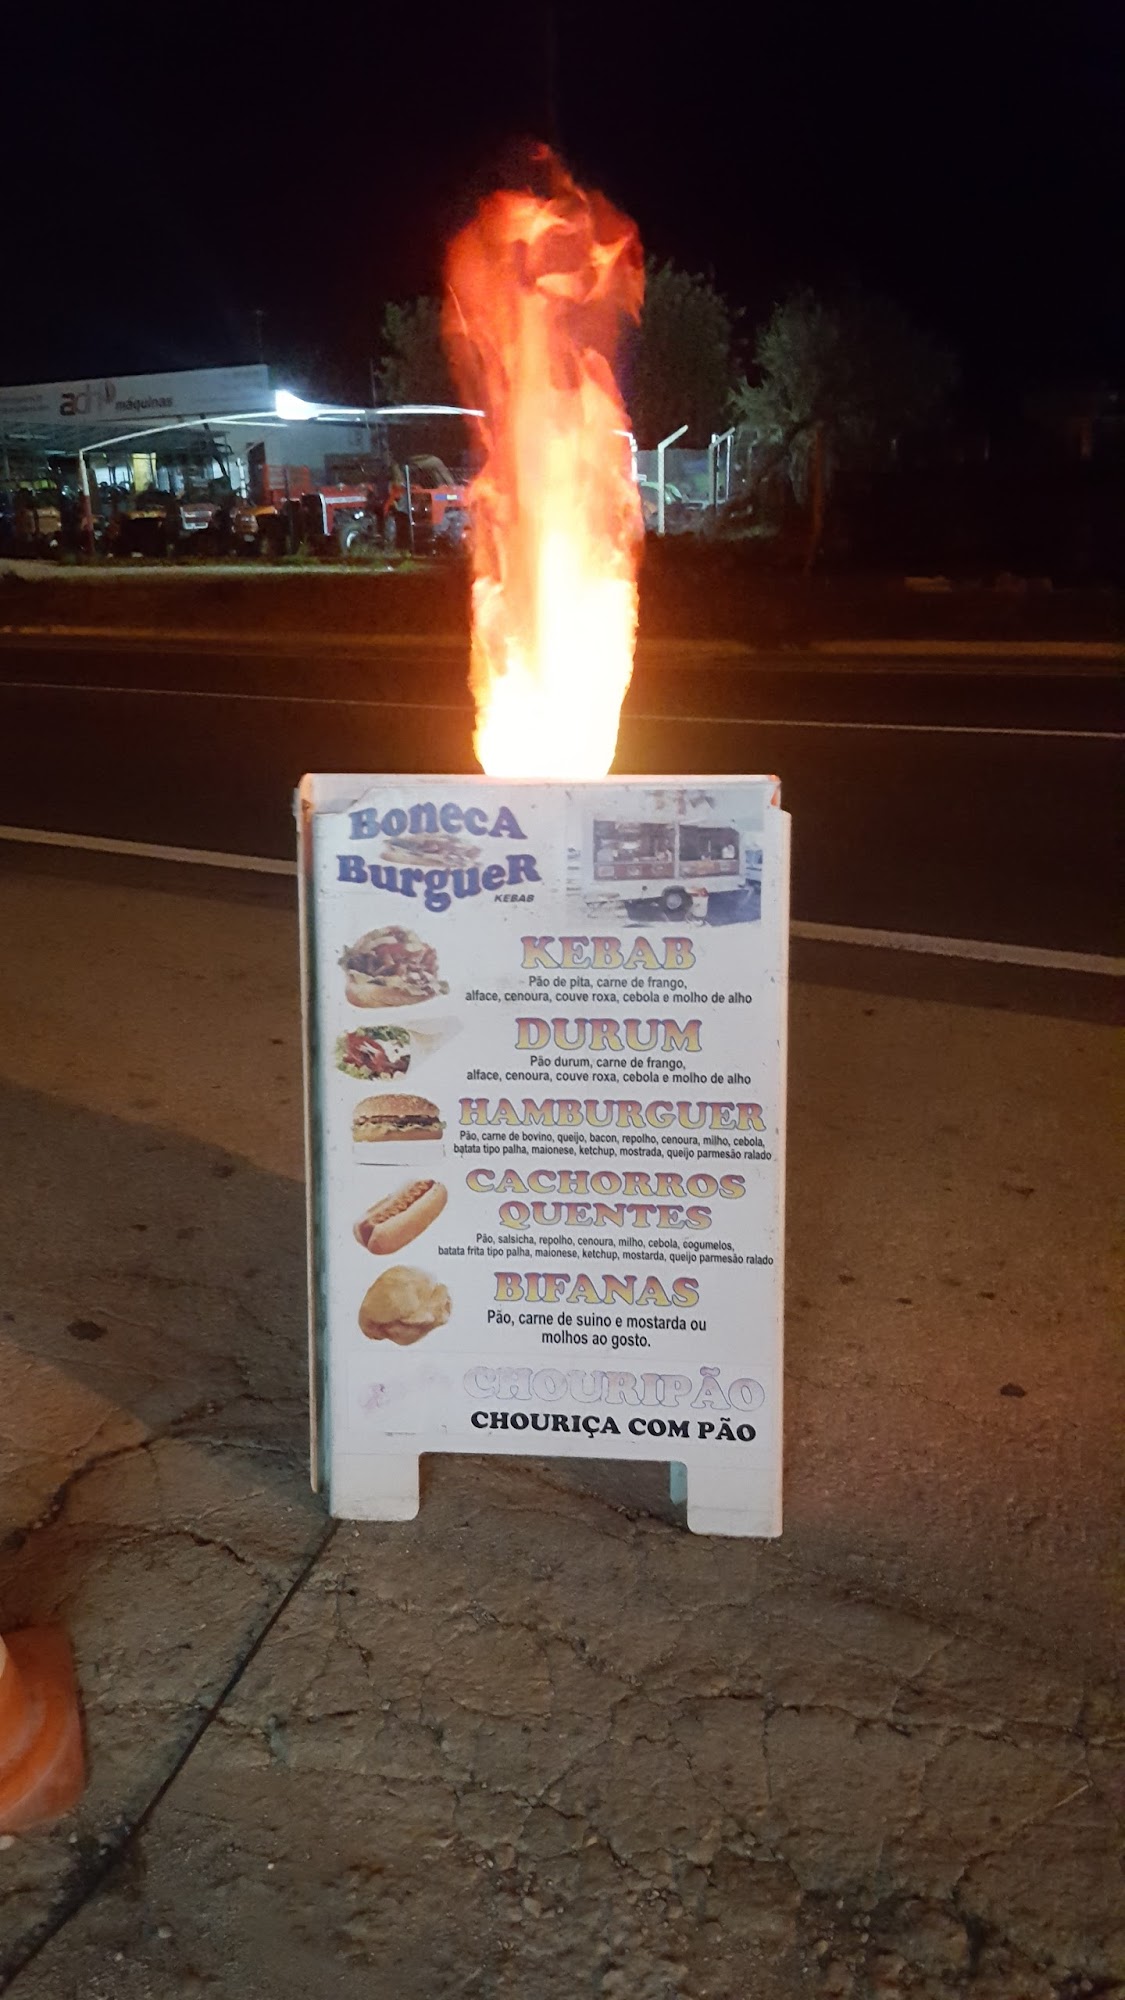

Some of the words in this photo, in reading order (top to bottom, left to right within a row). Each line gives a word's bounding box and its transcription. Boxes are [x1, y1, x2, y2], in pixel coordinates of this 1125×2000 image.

[494, 893, 535, 903] KEBAB
[520, 935, 697, 970] KEBAB
[528, 975, 550, 988] Pão
[553, 976, 567, 988] de
[570, 976, 593, 990] pita,
[597, 978, 628, 988] carne
[630, 976, 645, 988] de
[647, 976, 687, 991] frango,
[465, 990, 501, 1002] alface,
[504, 992, 551, 1003] cenoura,
[555, 993, 589, 1002] couve
[592, 993, 620, 1004] roxa,
[623, 991, 660, 1003] cebola
[663, 994, 670, 1003] e
[672, 991, 708, 1003] molho
[711, 992, 725, 1004] de
[728, 992, 752, 1004] alho
[514, 1017, 702, 1052] DURUM
[530, 1055, 551, 1067] Pão
[554, 1056, 593, 1069] durum,
[596, 1058, 627, 1068] carne
[630, 1057, 644, 1068] de
[647, 1057, 686, 1071] frango,
[466, 1069, 502, 1082] alface,
[505, 1071, 553, 1082] cenoura,
[556, 1072, 589, 1082] couve
[592, 1073, 620, 1083] roxa,
[623, 1071, 660, 1083] cebola
[662, 1074, 669, 1083] e
[672, 1072, 708, 1084] molho
[710, 1073, 726, 1084] de
[727, 1073, 751, 1085] alho
[458, 1098, 767, 1131] HAMBURGUER
[460, 1131, 479, 1141] Pão,
[481, 1132, 506, 1141] carne
[509, 1131, 520, 1141] de
[522, 1132, 555, 1142] bovino,
[557, 1132, 587, 1144] queijo,
[590, 1132, 619, 1143] bacon,
[622, 1133, 658, 1145] repolho,
[662, 1135, 700, 1146] cenoura,
[703, 1135, 730, 1146] milho,
[733, 1136, 765, 1147] cebola,
[454, 1144, 480, 1154] batata
[483, 1144, 500, 1155] tipo
[502, 1145, 529, 1155] palha,
[531, 1145, 577, 1156] maionese,
[580, 1146, 617, 1157] ketchup,
[620, 1147, 664, 1158] mostrada,
[667, 1148, 694, 1161] queijo
[697, 1149, 742, 1160] parmesão
[744, 1150, 772, 1160] ralado
[465, 1168, 746, 1199] CACHORROS
[499, 1200, 713, 1230] QUENTES
[476, 1233, 495, 1244] Pão,
[498, 1234, 536, 1245] salsicha,
[539, 1235, 575, 1247] repolho,
[578, 1236, 615, 1247] cenoura,
[618, 1236, 645, 1248] milho,
[648, 1238, 680, 1249] cebola,
[683, 1239, 735, 1252] cogumelos,
[438, 1246, 465, 1256] batata
[467, 1246, 484, 1256] frita
[487, 1246, 504, 1258] tipo
[506, 1246, 532, 1258] palha,
[535, 1248, 579, 1259] maionese,
[582, 1248, 619, 1261] ketchup,
[622, 1250, 666, 1261] mostarda,
[669, 1251, 697, 1264] queijo
[700, 1252, 744, 1264] parmesão
[746, 1254, 774, 1265] ralado
[493, 1271, 700, 1308] BIFANAS
[487, 1309, 515, 1326] Pão,
[518, 1313, 553, 1325] carne
[557, 1311, 572, 1326] de
[615, 1316, 623, 1327] e
[626, 1315, 686, 1330] mostarda
[690, 1318, 706, 1331] ou
[542, 1330, 588, 1345] molhos
[592, 1334, 607, 1346] ao
[611, 1333, 651, 1349] gosto.
[463, 1366, 766, 1412] CHOURIPÃO
[470, 1411, 621, 1438] CHOURIÇA
[628, 1418, 690, 1438] COM
[697, 1417, 756, 1442] PÃO
